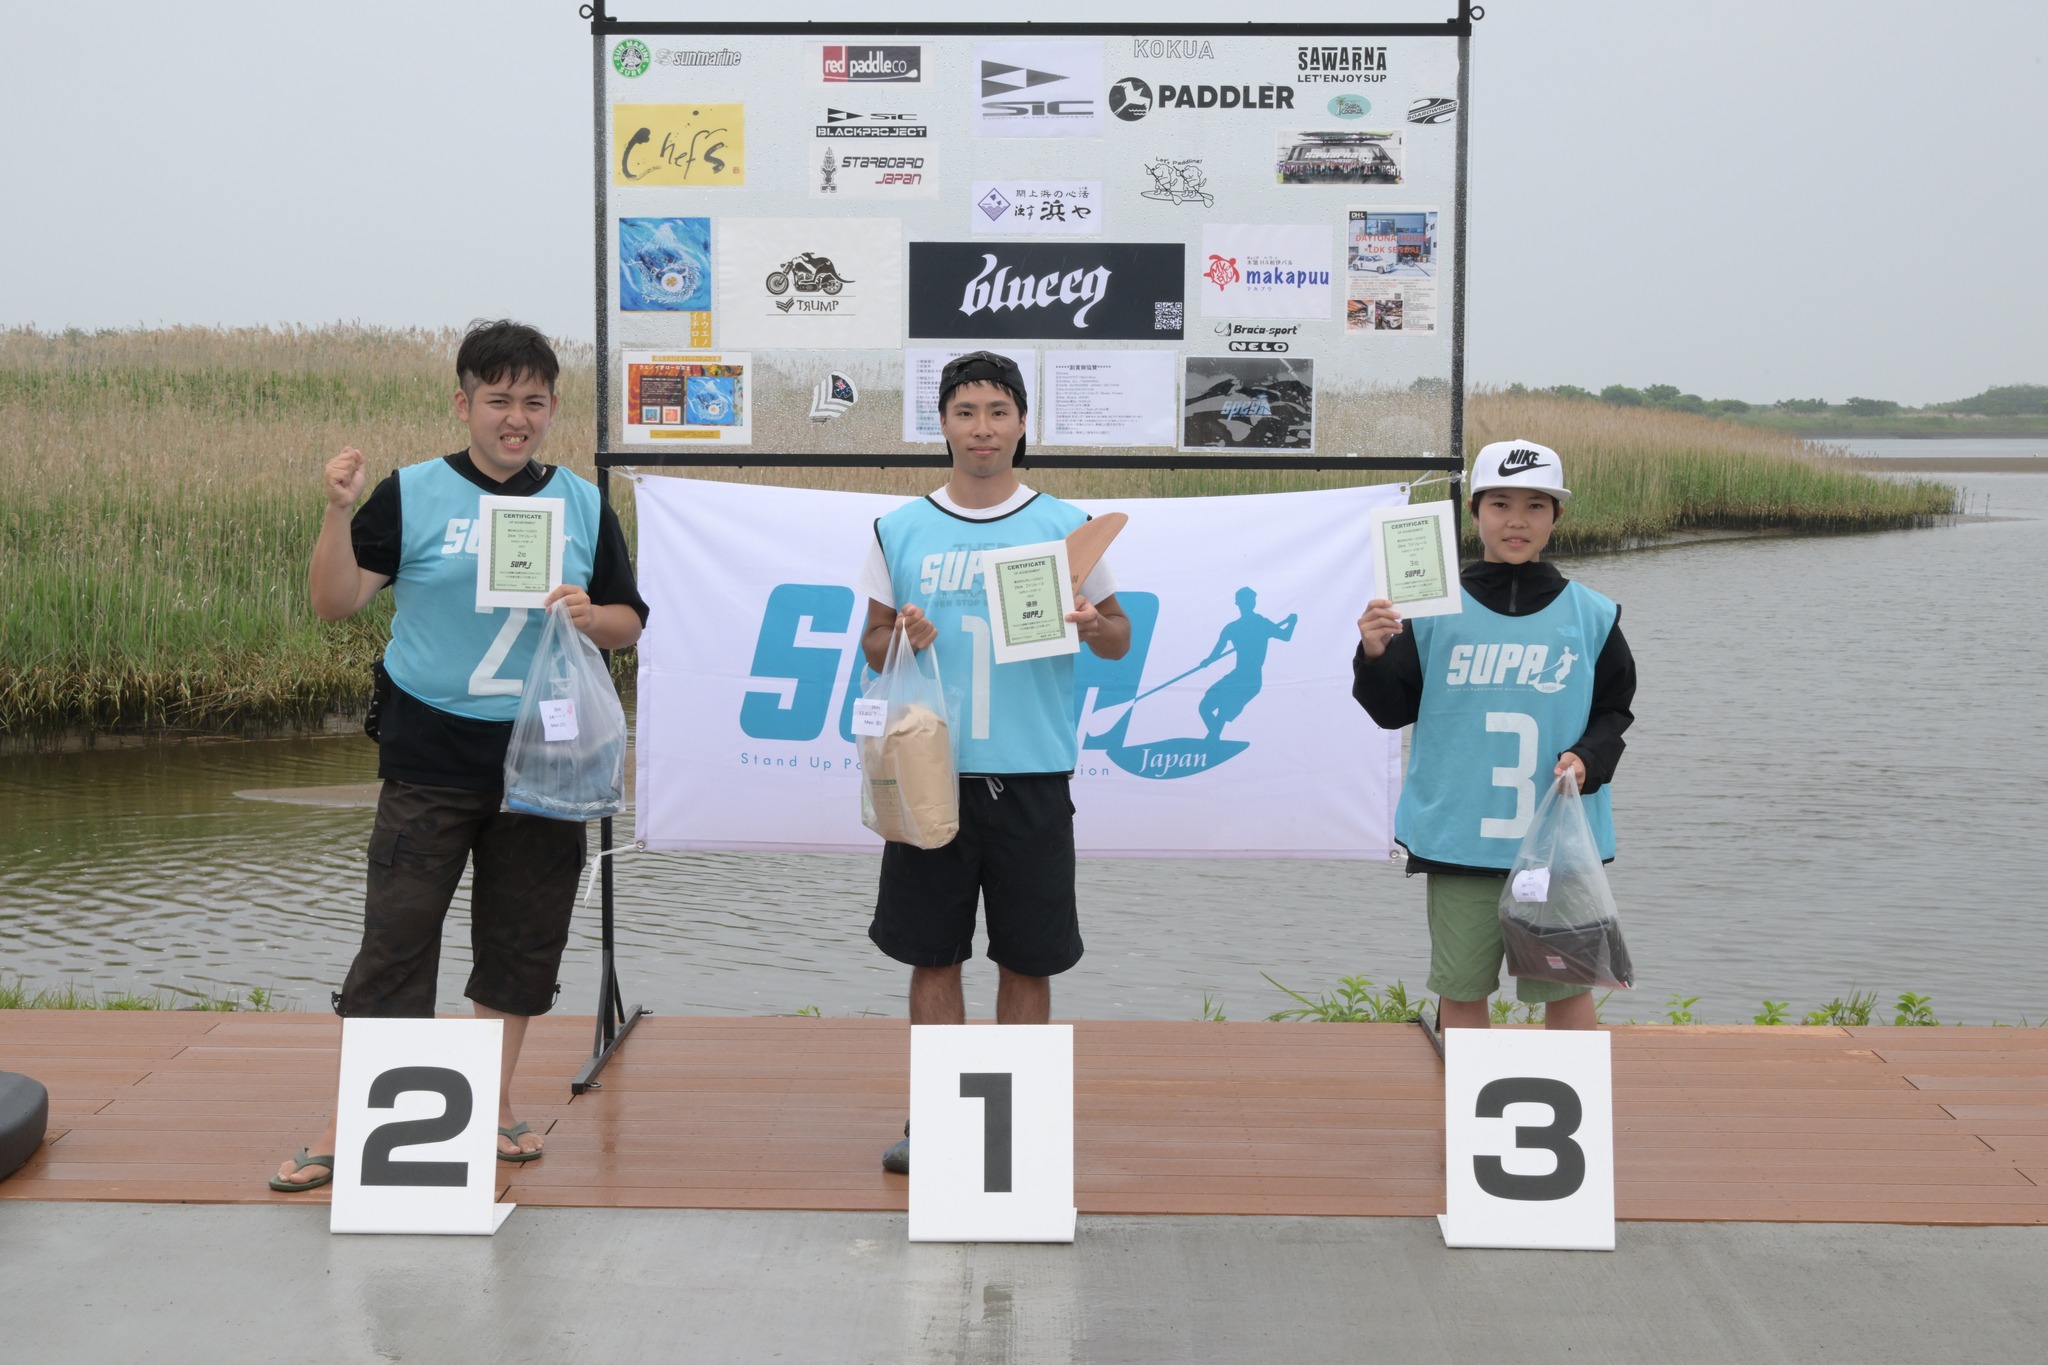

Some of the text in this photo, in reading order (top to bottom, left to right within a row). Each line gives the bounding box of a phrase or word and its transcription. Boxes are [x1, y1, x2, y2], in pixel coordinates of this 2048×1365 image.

[613, 40, 649, 63] SUN MARINE
[673, 48, 742, 67] sunmarine
[825, 46, 846, 73] red
[1134, 40, 1215, 60] KOKUA
[1298, 47, 1387, 71] SAWARNA
[618, 67, 642, 77] SURF
[1158, 85, 1295, 109] PADDLER
[1407, 102, 1458, 121] BOARDWORKS
[818, 127, 926, 137] BLACKPROJECT
[842, 156, 924, 169] STARBOARD
[876, 173, 922, 185] JAPAN
[1355, 234, 1397, 242] DAYTONA
[1246, 267, 1329, 288] makapuu
[1231, 342, 1287, 351] NELO
[1506, 449, 1539, 466] NIKE
[1391, 519, 1429, 530] CERTIFICATE
[1007, 560, 1047, 571] CERTIFICATE
[1446, 644, 1549, 686] SUPA
[961, 615, 991, 740] 1
[741, 752, 797, 767] Stand
[809, 757, 832, 772] Up
[1141, 748, 1208, 777] Japan
[1480, 711, 1539, 838] 3
[361, 1067, 473, 1187] 2
[960, 1074, 1012, 1193] 1
[1474, 1078, 1586, 1201] 3
